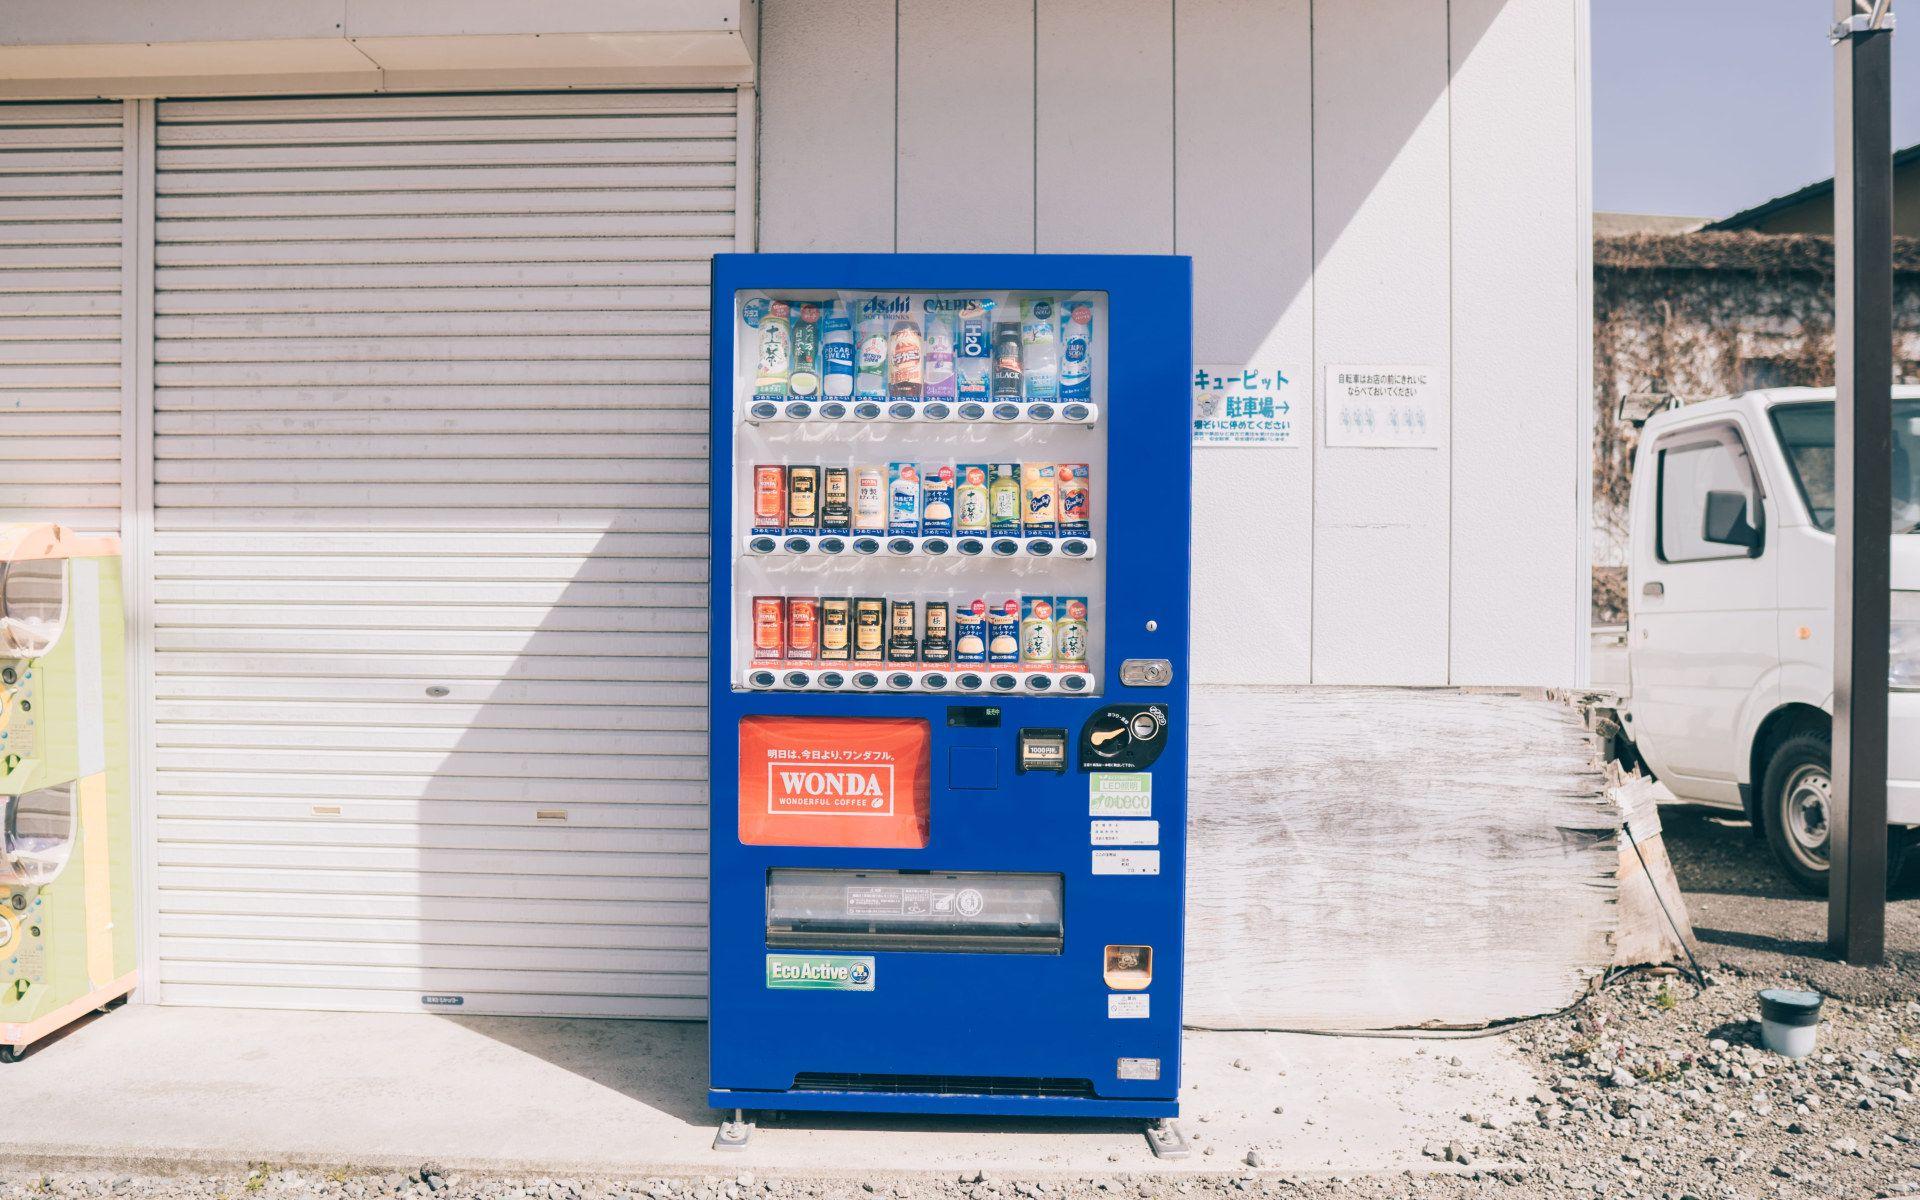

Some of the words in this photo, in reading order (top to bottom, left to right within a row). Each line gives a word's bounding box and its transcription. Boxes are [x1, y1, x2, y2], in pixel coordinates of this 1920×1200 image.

[863, 296, 911, 313] Asahi
[923, 298, 976, 313] CALPIS
[965, 325, 982, 356] H2O
[1194, 369, 1289, 390] キューピット
[1338, 373, 1428, 385] 自転車はお店の前にきれいに
[1226, 396, 1275, 418] 駐車場
[767, 749, 895, 761] 明日は、今日より、ワンダフル。
[780, 772, 883, 795] WONDA
[780, 798, 831, 806] WONDERFUL
